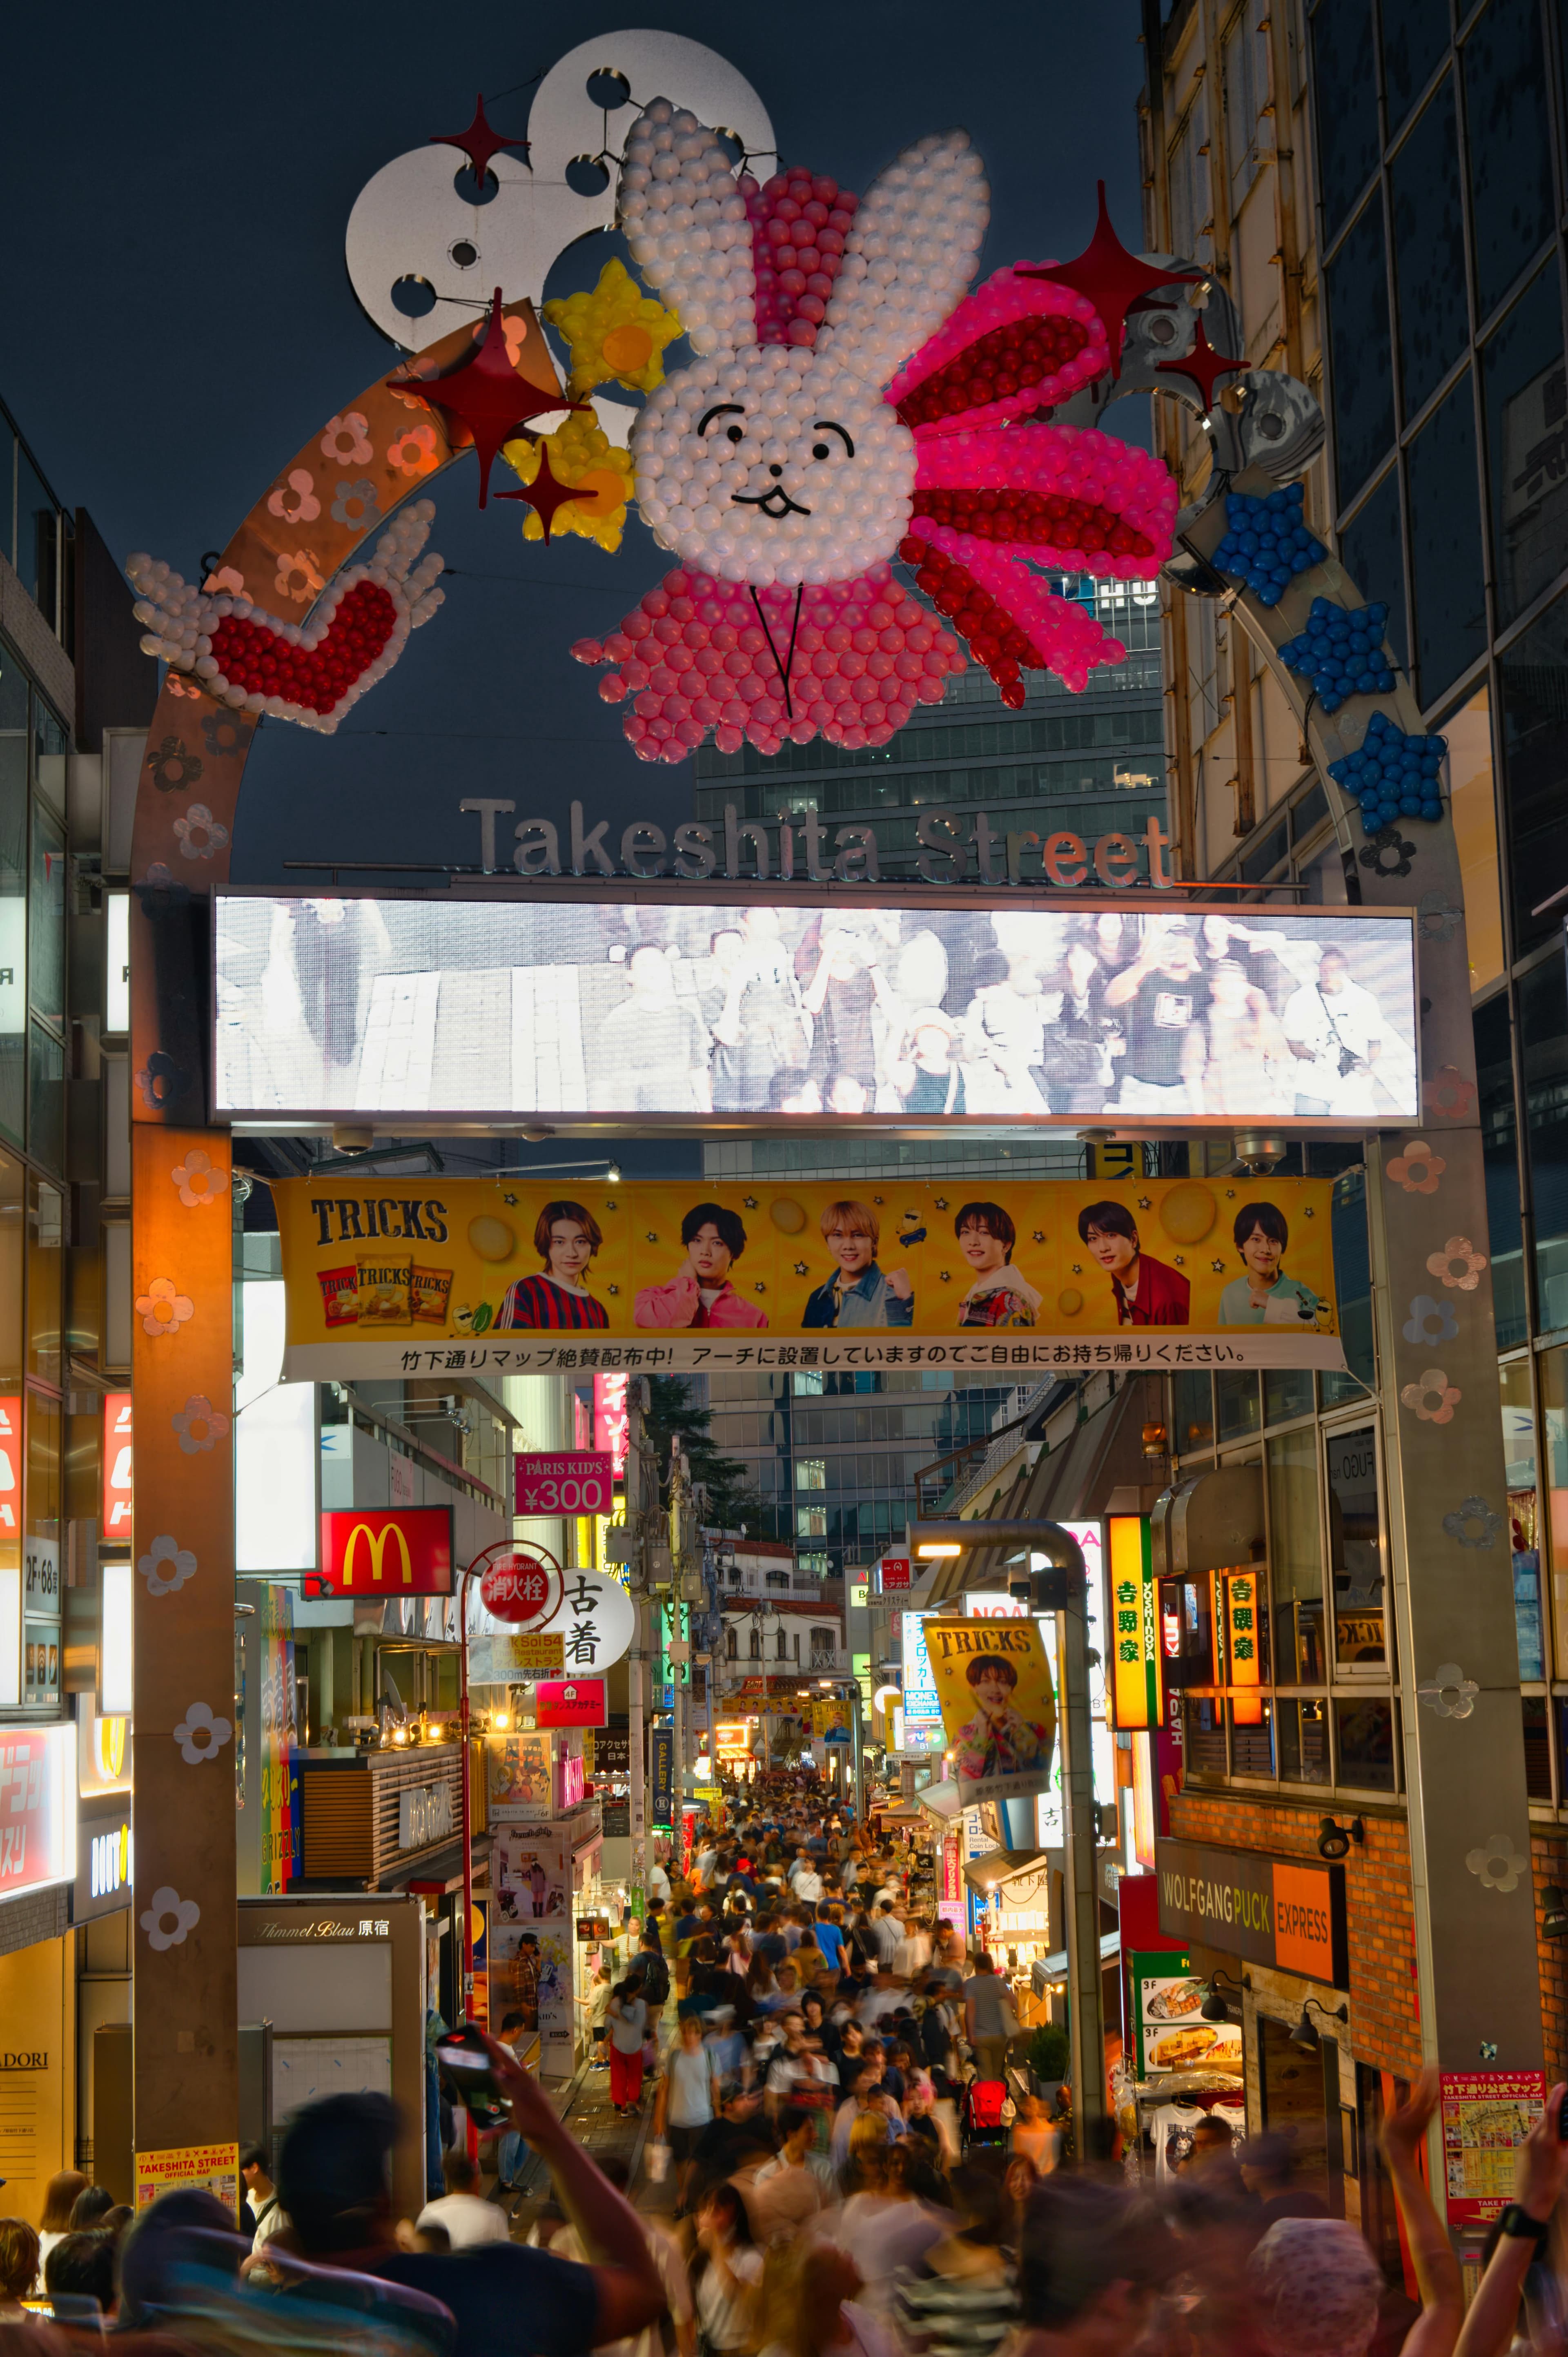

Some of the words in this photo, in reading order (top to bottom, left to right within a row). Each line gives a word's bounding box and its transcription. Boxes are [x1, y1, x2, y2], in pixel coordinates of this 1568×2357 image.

[460, 798, 882, 882] Takeshita
[916, 811, 1173, 889] Street
[310, 1199, 448, 1246] TRICKS
[358, 1268, 409, 1286] TRICKS
[401, 1347, 673, 1371] 竹下通りマップ絶賛配布中!
[693, 1344, 1245, 1366] アーチに設置していますのでご自由にお持ち帰りください。
[526, 1460, 565, 1475] PARIS
[568, 1461, 603, 1475] KID'S
[525, 1479, 602, 1510] ¥300
[488, 1575, 544, 1601] 消火栓
[883, 1596, 909, 1605] クリスティー
[564, 1575, 603, 1665] 古着
[1116, 1580, 1140, 1663] 吉野家
[521, 1636, 541, 1647] Soi
[543, 1635, 562, 1646] 54
[937, 1630, 1031, 1658] TRICKS
[495, 1657, 562, 1667] タイレストラン
[493, 1669, 549, 1680] 300m先右折
[906, 1691, 938, 1700] MONEY
[261, 1827, 300, 1865] GRIZZLY
[1163, 1871, 1232, 1923] WOLFGANG
[1234, 1887, 1270, 1934] PUCK
[314, 1921, 354, 1937] Blau
[359, 1919, 389, 1936] 原宿
[1277, 1902, 1327, 1944] EXPRESS
[1143, 1981, 1156, 1989] 3F
[1145, 2028, 1158, 2037] 3F
[0, 2052, 48, 2067] DORI
[1443, 2082, 1542, 2095] 竹下通り公式マップ
[139, 2160, 195, 2174] TAKESHITA
[198, 2156, 235, 2168] STREET
